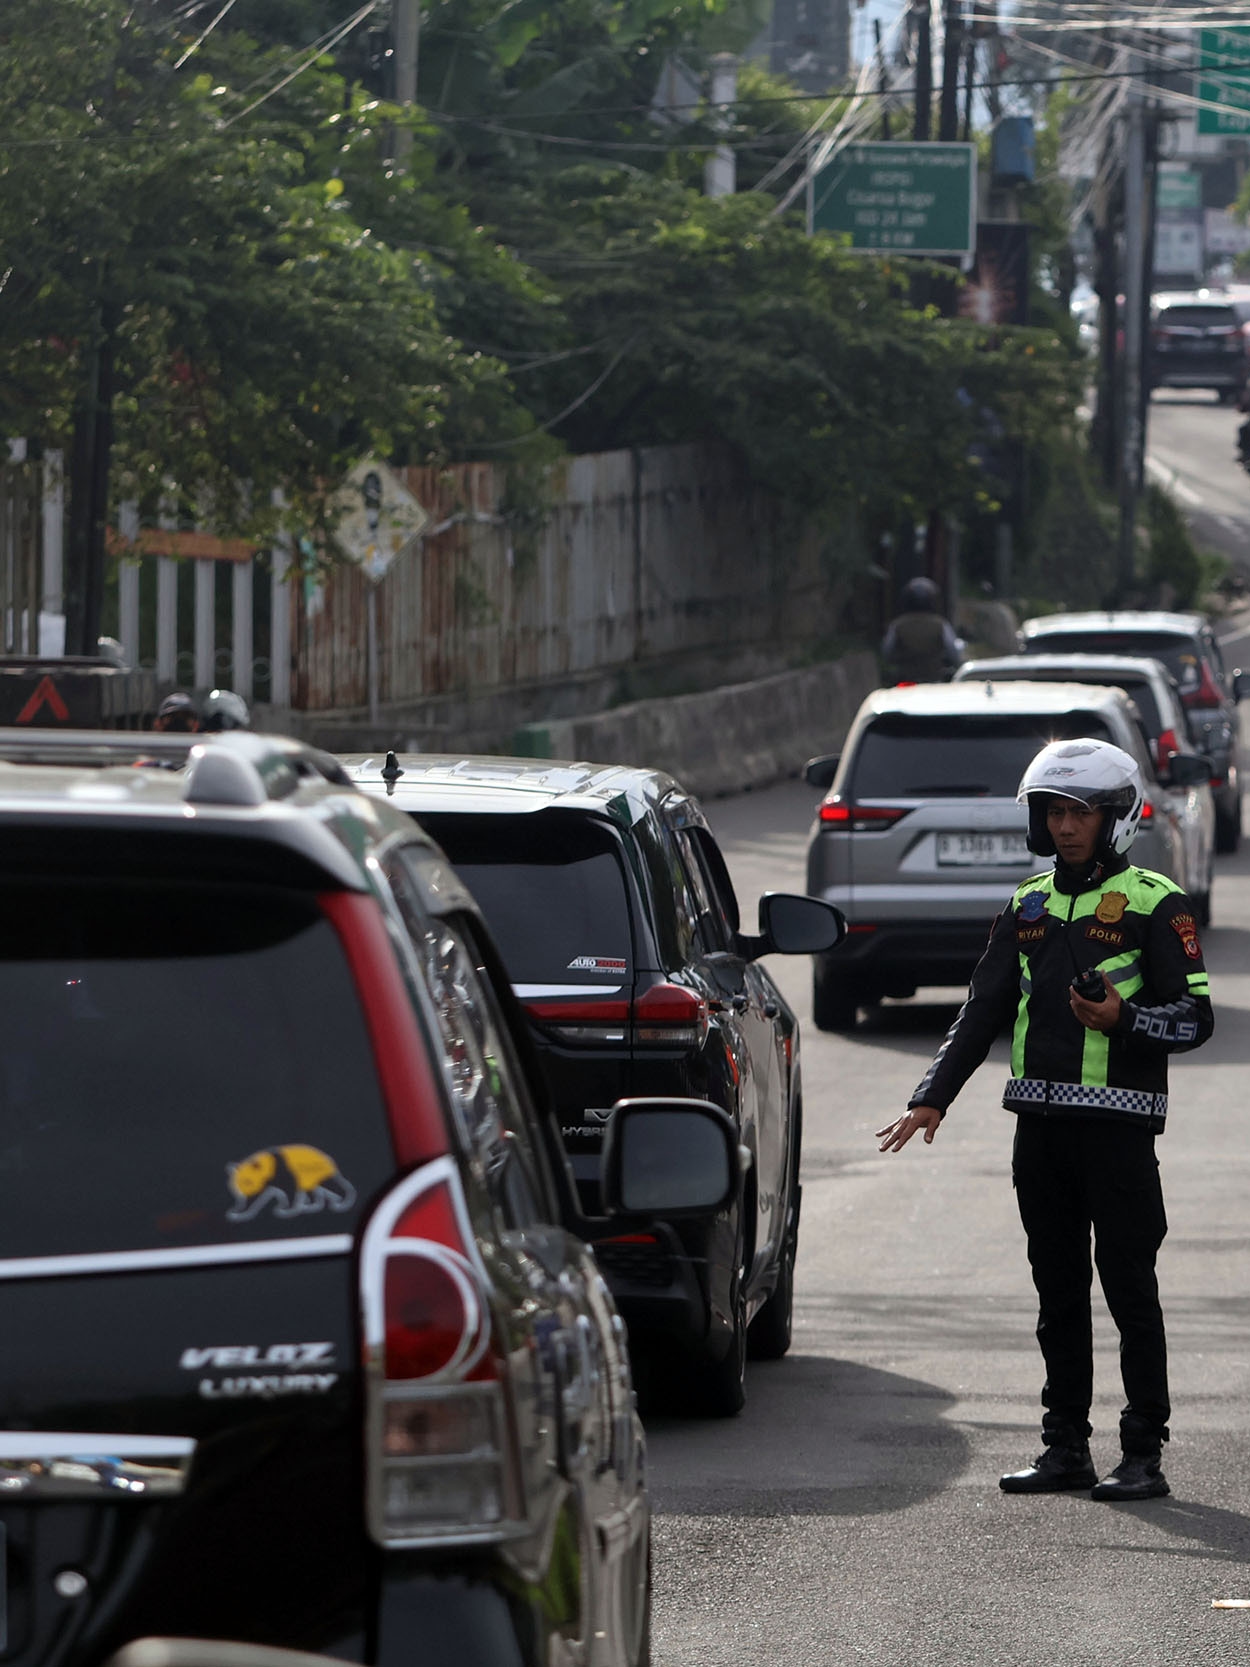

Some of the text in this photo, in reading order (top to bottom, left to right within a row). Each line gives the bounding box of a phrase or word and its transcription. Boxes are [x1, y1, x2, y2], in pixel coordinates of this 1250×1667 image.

[1018, 927, 1046, 941] RIYAN
[1089, 928, 1122, 943] POLRI
[180, 1342, 336, 1370] VELOZ
[200, 1373, 338, 1398] LUXURY
